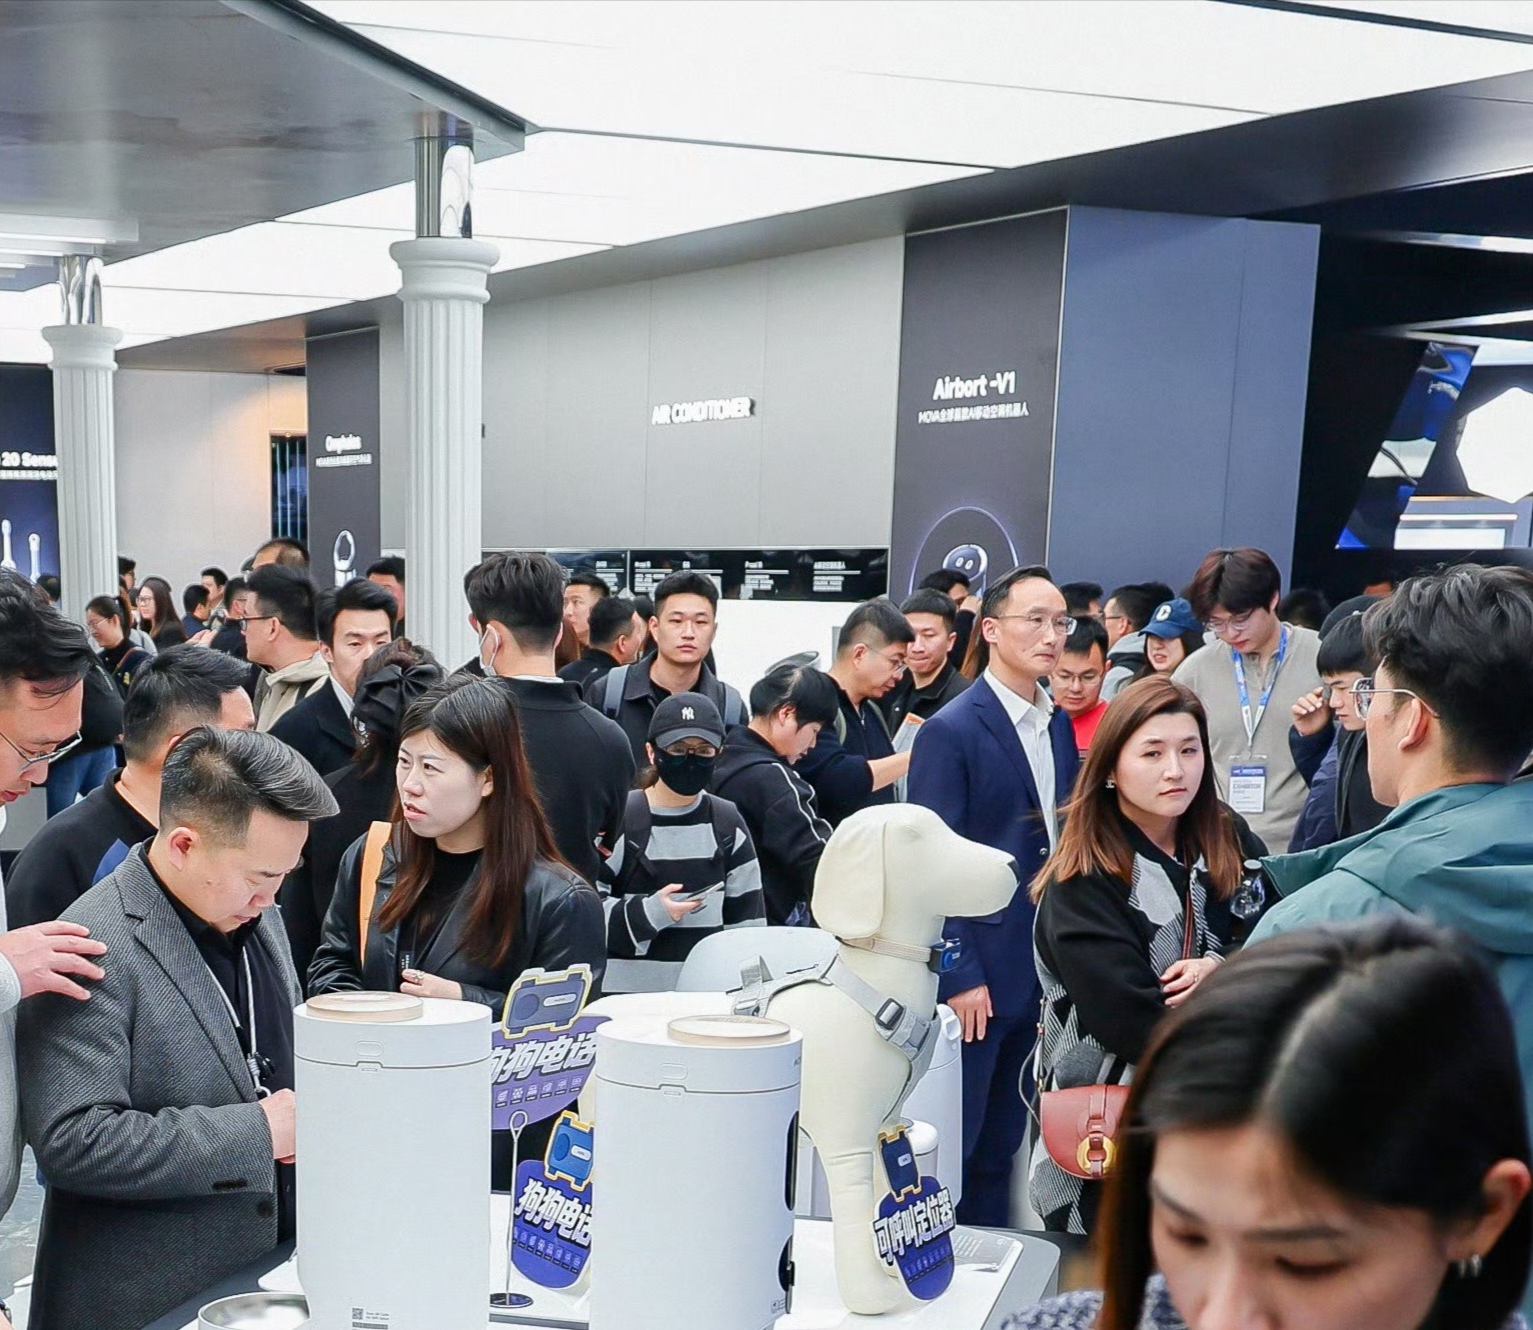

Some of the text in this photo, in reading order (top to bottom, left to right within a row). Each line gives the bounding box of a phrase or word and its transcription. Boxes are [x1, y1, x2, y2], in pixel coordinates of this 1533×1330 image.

[1, 451, 20, 466] 20
[874, 1187, 955, 1263] 可呼叫定位器
